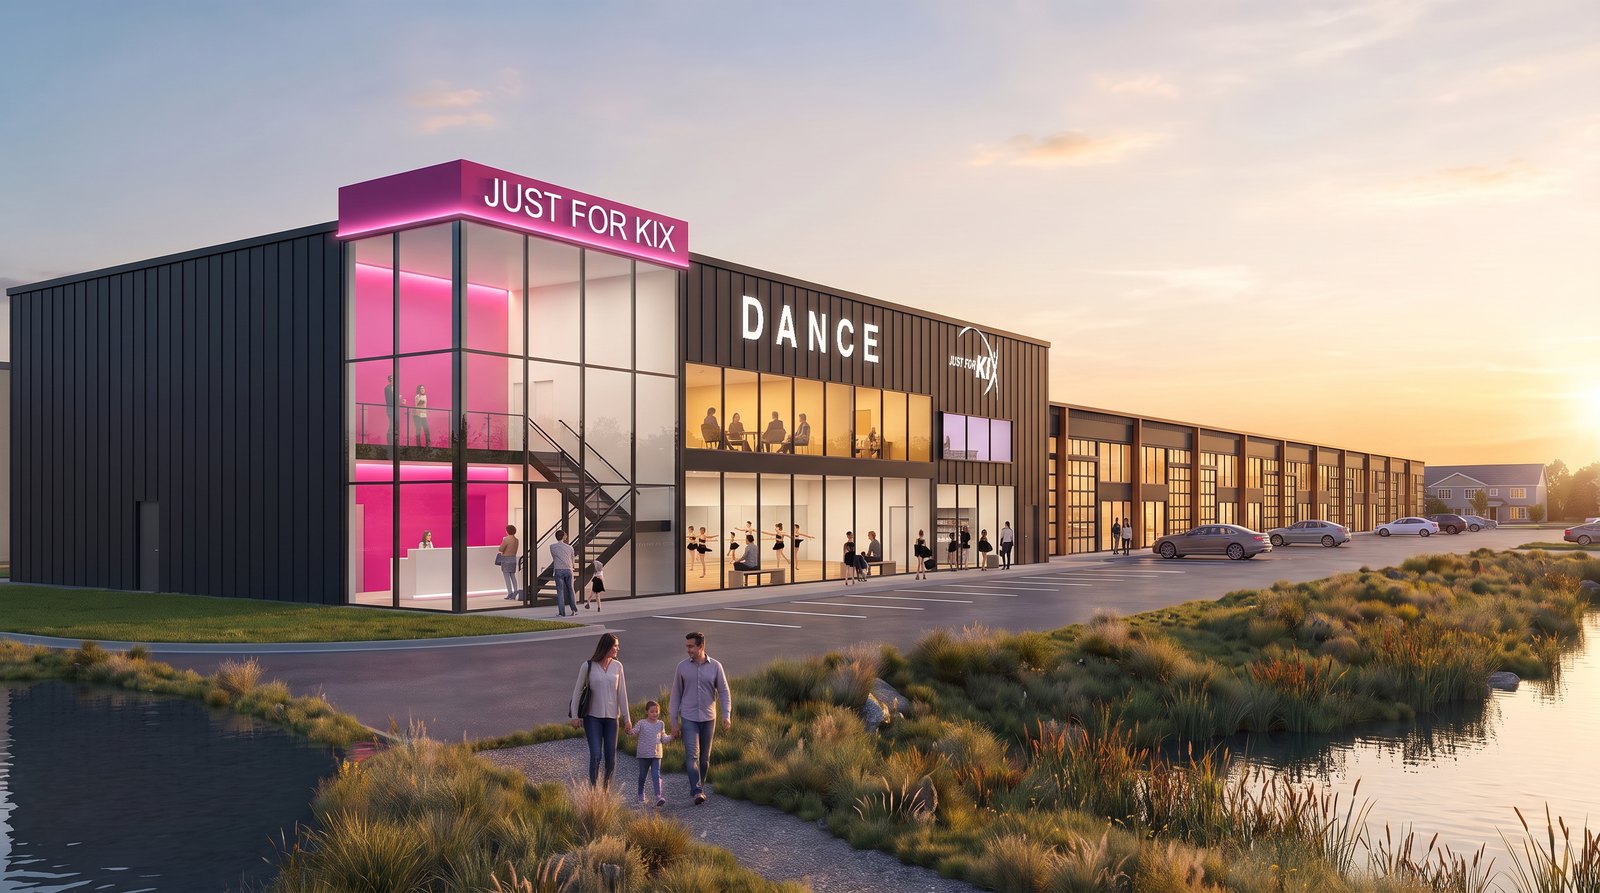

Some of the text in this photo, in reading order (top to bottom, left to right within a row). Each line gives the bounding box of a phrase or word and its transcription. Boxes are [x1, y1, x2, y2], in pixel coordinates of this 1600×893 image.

[484, 177, 676, 252] JUST FOR KIX
[742, 295, 879, 363] DANCE
[949, 355, 964, 367] JUST
[964, 358, 976, 371] FOR
